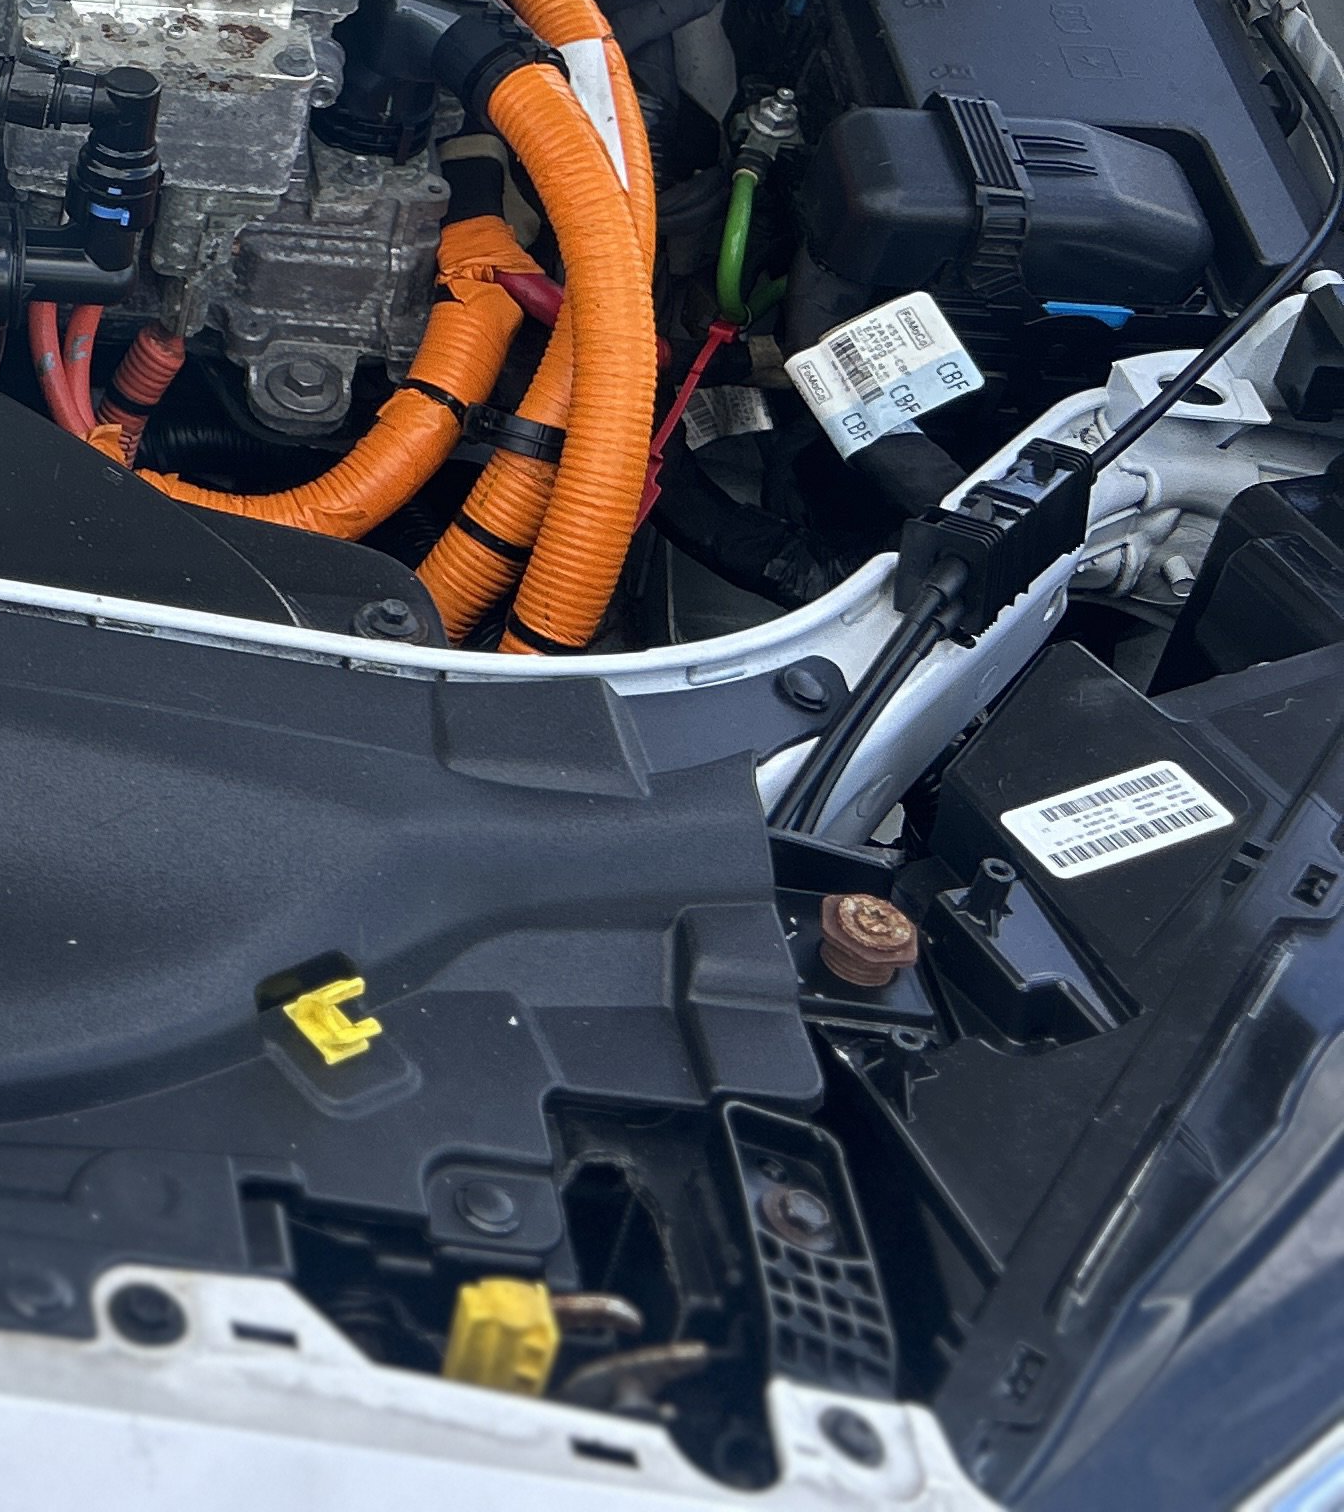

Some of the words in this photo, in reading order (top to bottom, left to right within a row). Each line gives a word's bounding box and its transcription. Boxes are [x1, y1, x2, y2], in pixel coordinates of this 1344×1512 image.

[902, 310, 928, 347] FoMoCo
[800, 365, 827, 402] FoMoCo
[936, 361, 971, 392] CBF
[889, 384, 922, 414] CBF
[841, 412, 874, 442] CBF
